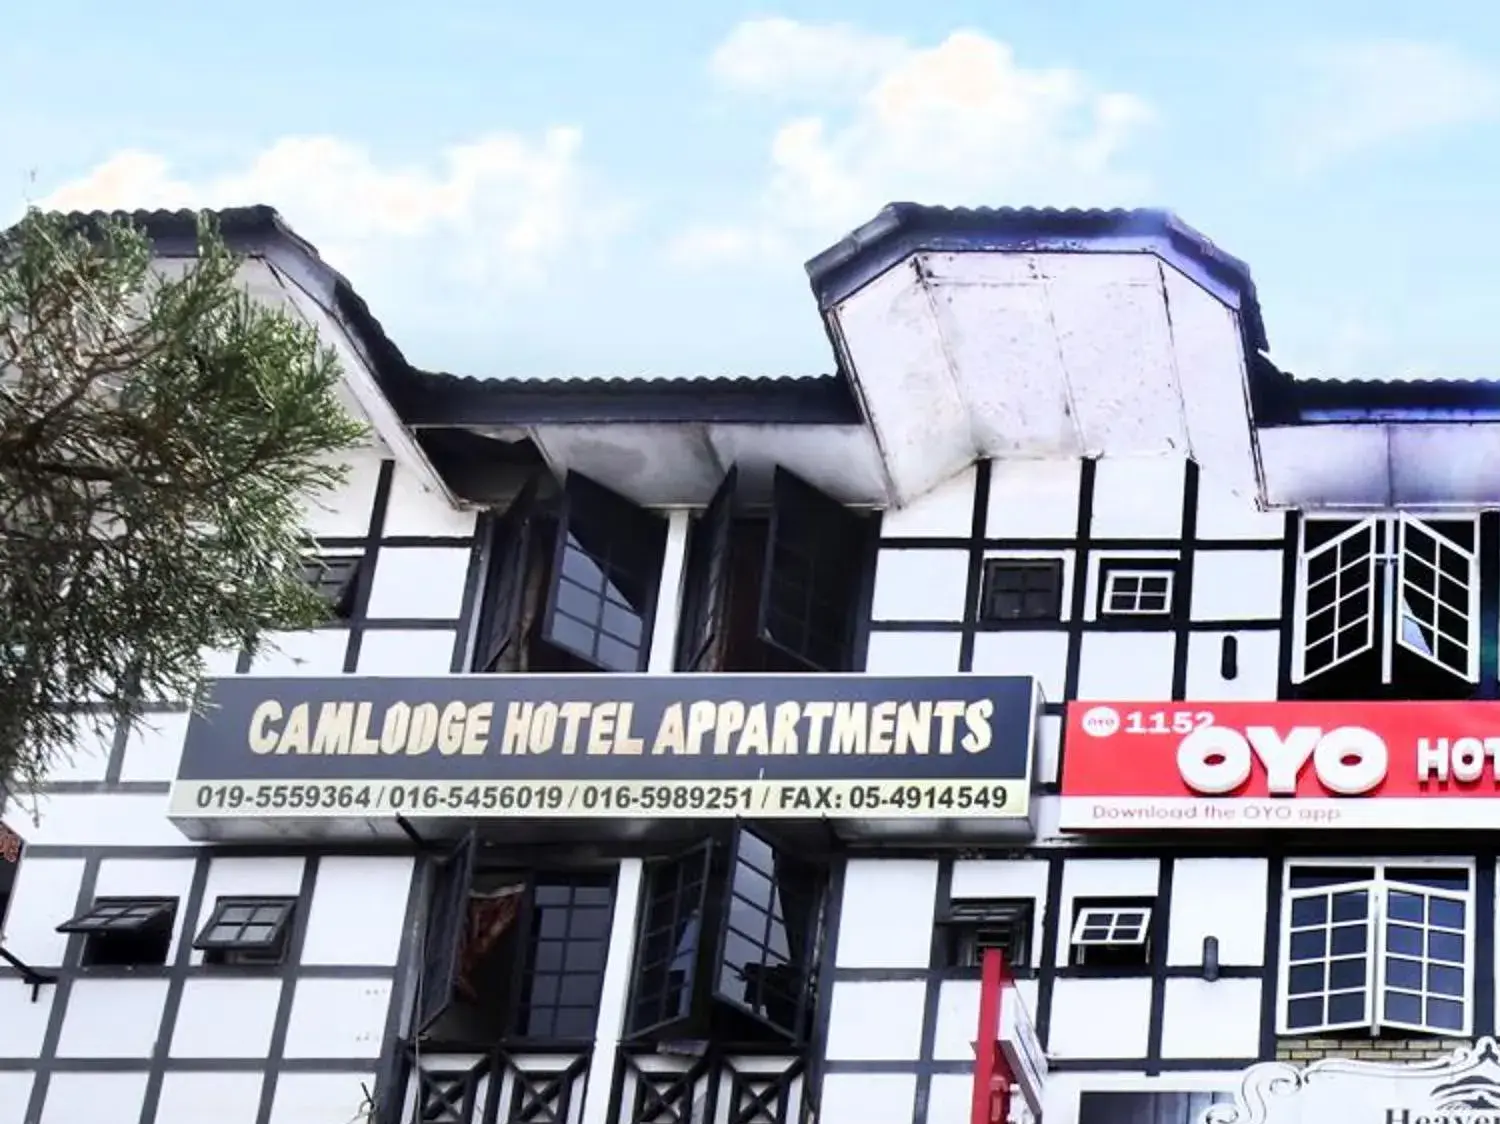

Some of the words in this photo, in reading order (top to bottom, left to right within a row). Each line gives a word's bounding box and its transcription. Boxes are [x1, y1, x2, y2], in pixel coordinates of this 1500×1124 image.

[248, 699, 495, 755] CAMLODGE
[502, 700, 643, 755] HOTEL
[652, 698, 994, 755] APPARTMENTS
[1125, 711, 1215, 734] 1152
[1177, 726, 1388, 796] OYO
[779, 785, 842, 809] FAX:
[849, 785, 1007, 809] 05-4914549
[1092, 805, 1197, 819] Download
[1204, 805, 1236, 819] the
[1243, 806, 1292, 819] OYO
[1299, 807, 1341, 823] app
